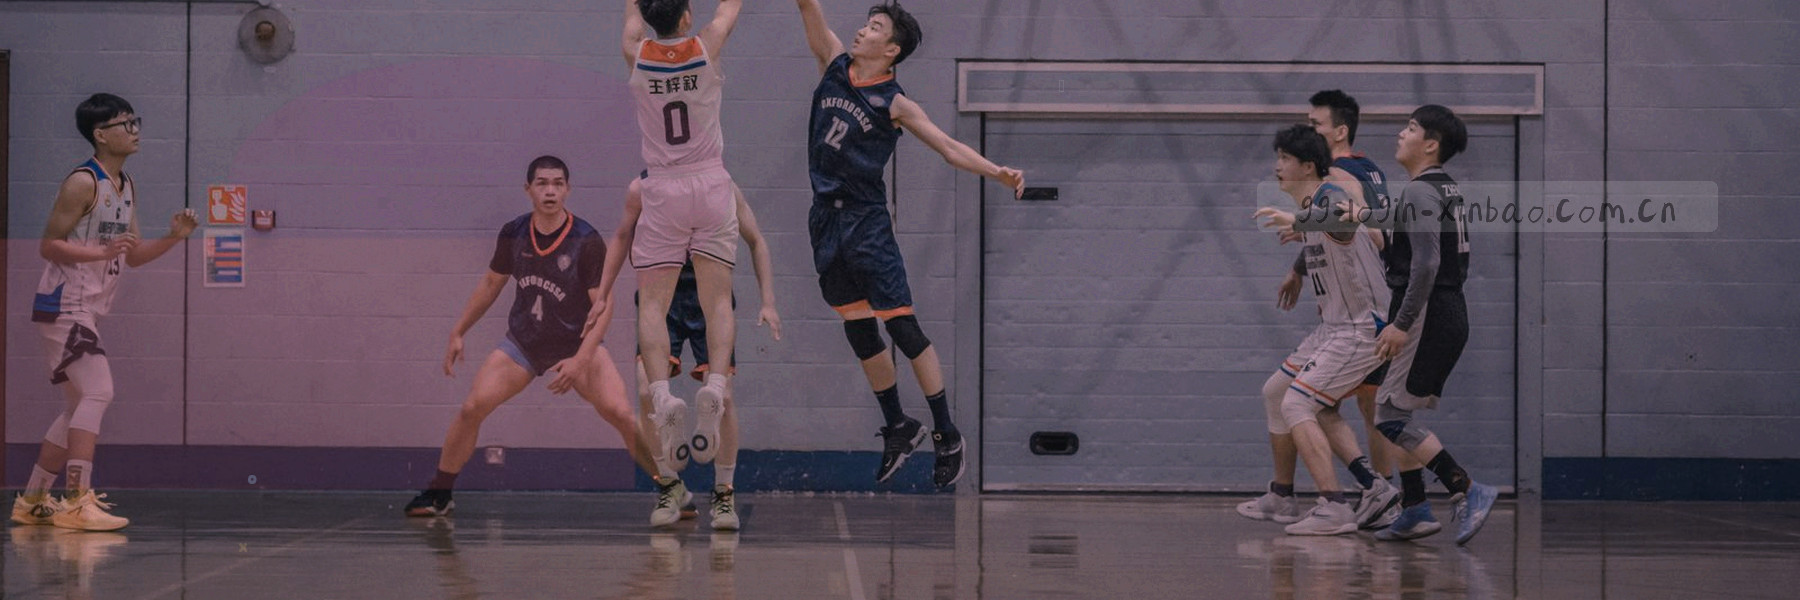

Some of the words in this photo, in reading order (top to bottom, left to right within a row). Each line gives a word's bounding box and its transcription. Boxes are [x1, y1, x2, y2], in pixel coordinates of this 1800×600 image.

[662, 100, 691, 146] 0
[821, 96, 855, 113] OXFORD
[852, 108, 873, 133] CSSA
[824, 115, 849, 151] 12
[1311, 272, 1326, 296] 11
[531, 294, 543, 321] 4
